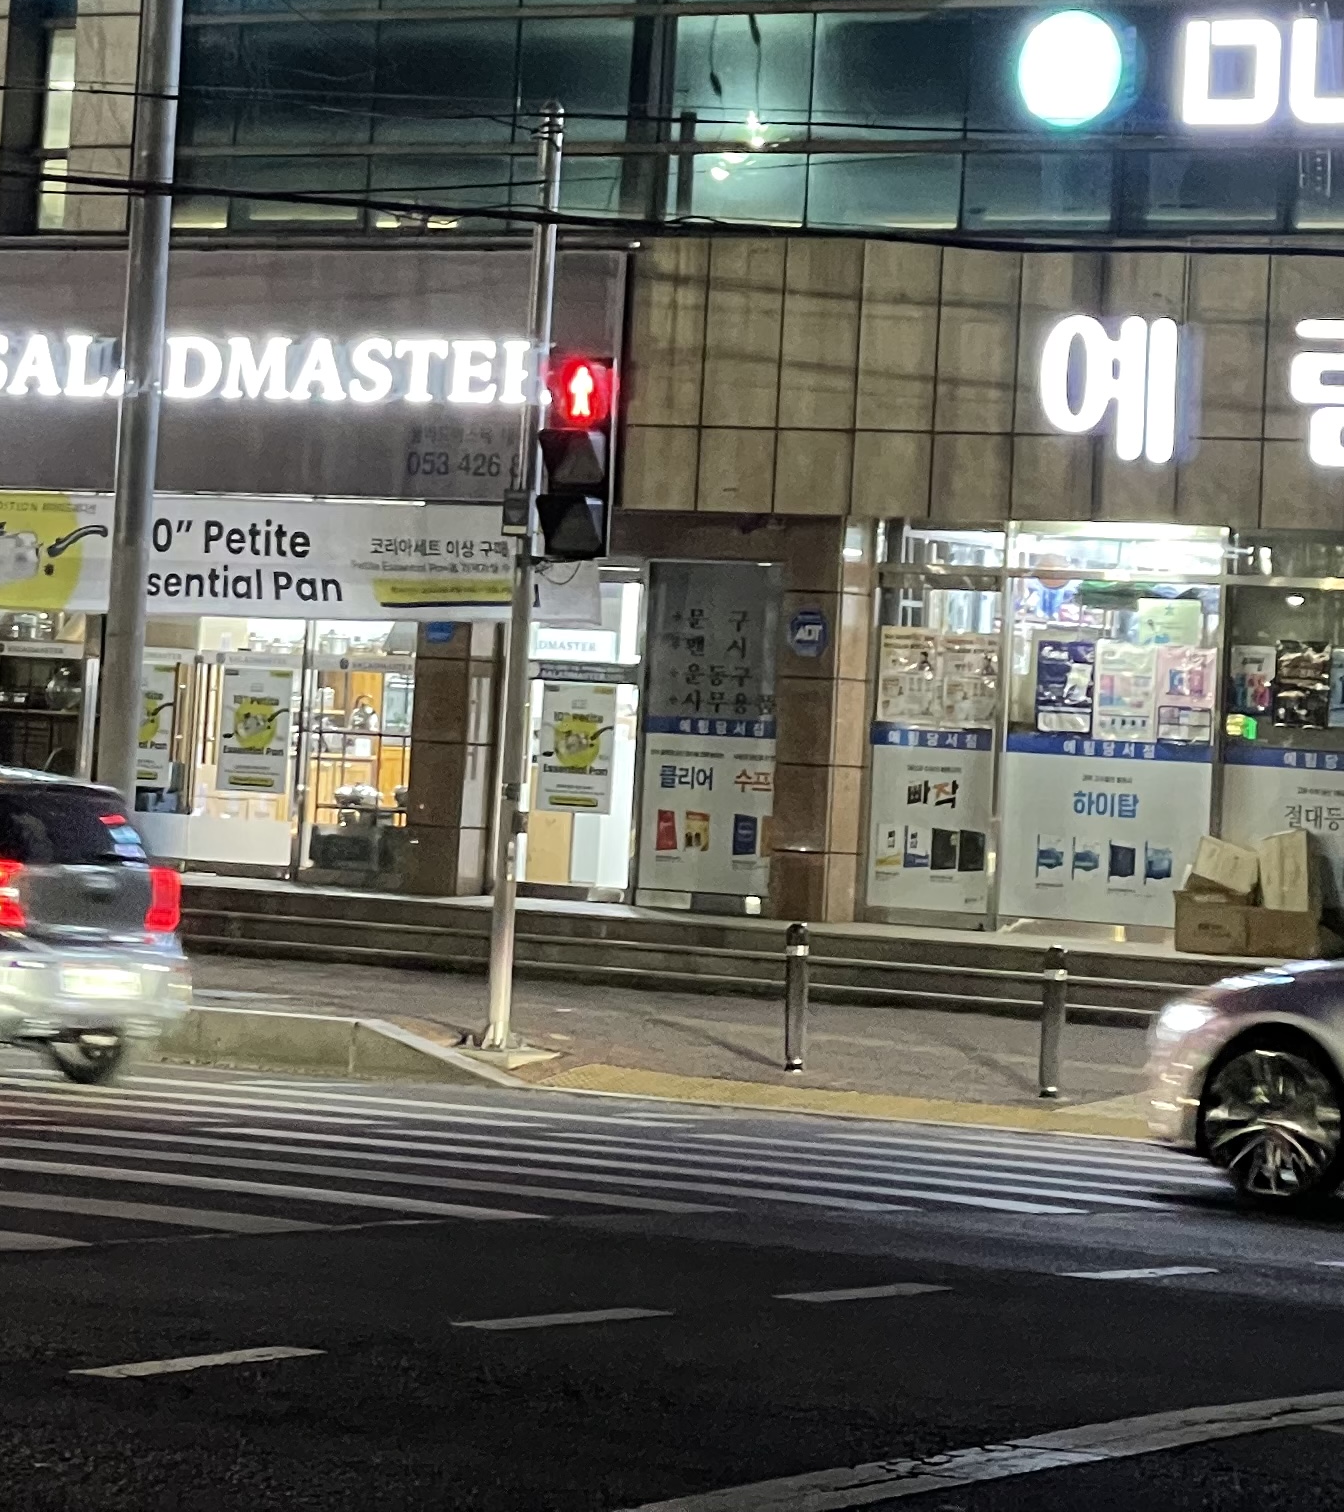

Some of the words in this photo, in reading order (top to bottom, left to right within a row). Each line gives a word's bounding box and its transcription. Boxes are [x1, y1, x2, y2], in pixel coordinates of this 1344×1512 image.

[407, 452, 449, 476] 053
[458, 453, 501, 477] 426
[204, 519, 311, 558] Petite
[370, 538, 441, 556] 코리아세트
[446, 540, 474, 558] 이상
[273, 571, 343, 602] Pan
[794, 624, 822, 641] ADT
[659, 765, 714, 791] 클리어
[1073, 790, 1139, 819] 하이탑
